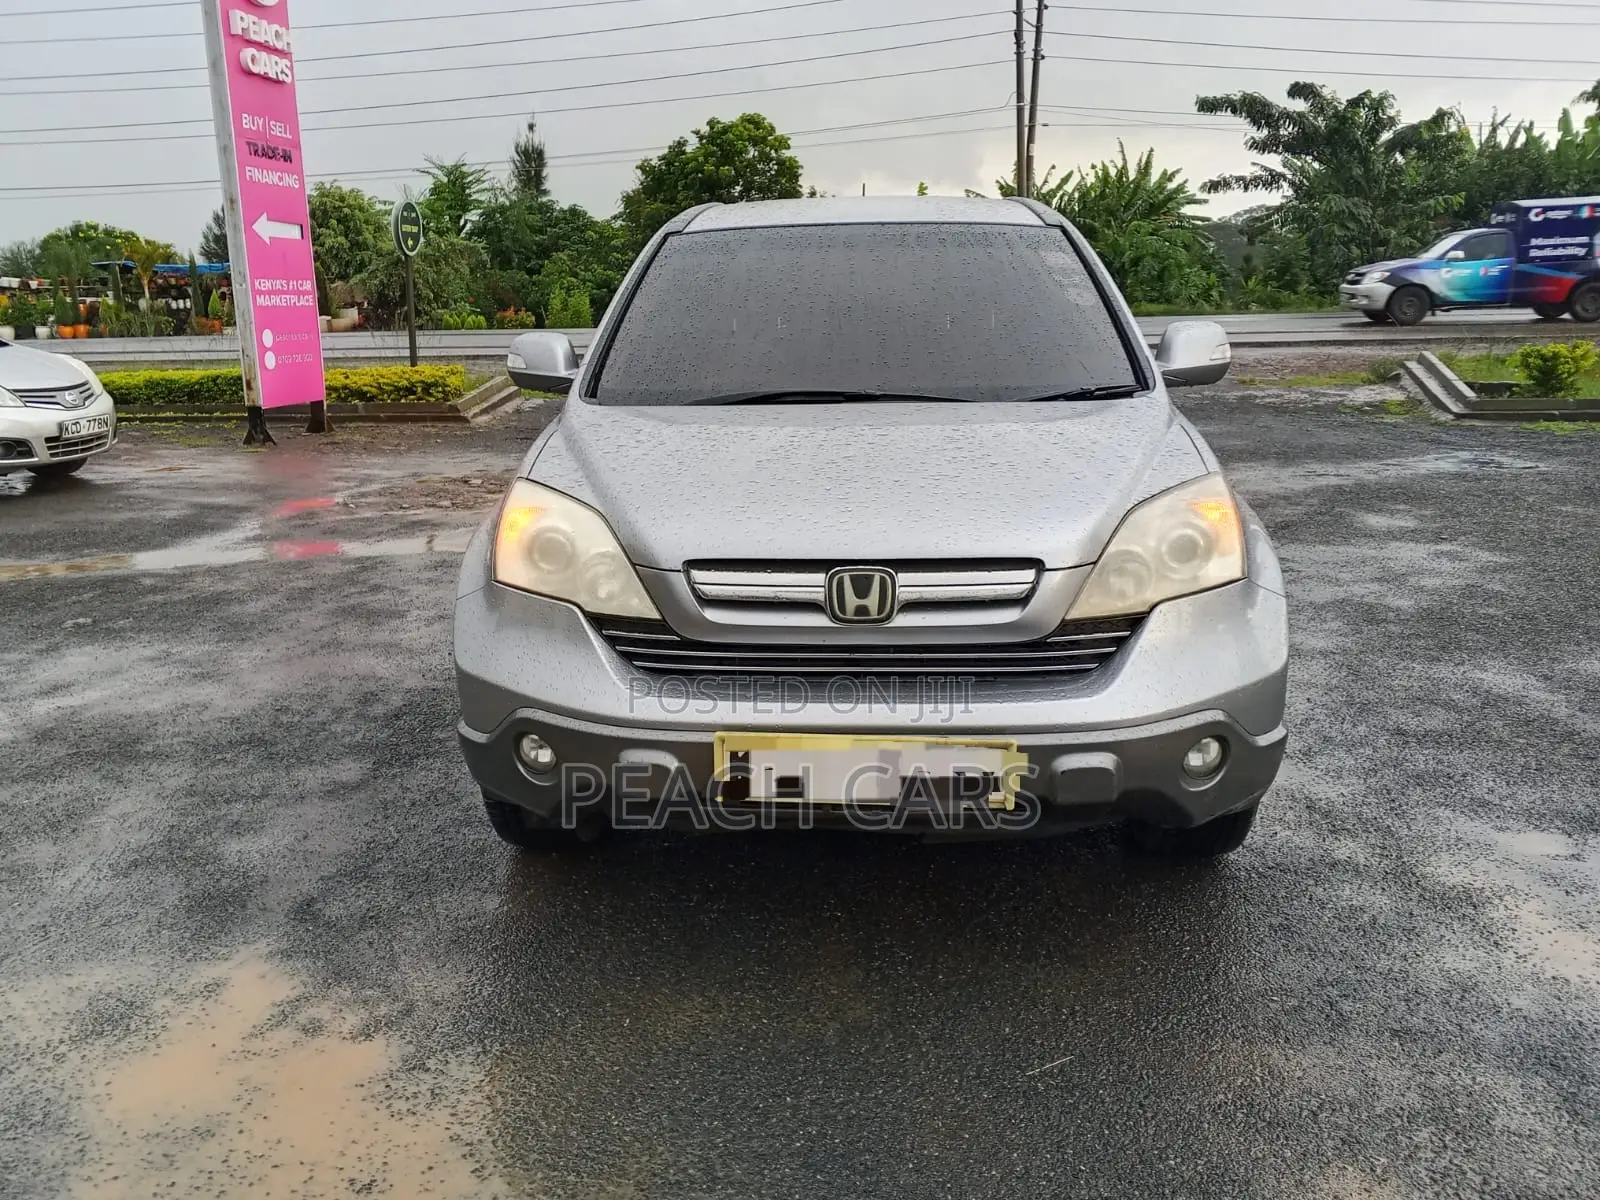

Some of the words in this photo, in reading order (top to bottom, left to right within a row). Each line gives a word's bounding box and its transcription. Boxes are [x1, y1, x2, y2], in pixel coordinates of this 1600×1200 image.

[228, 9, 292, 53] PEACH
[240, 47, 292, 84] CARS
[241, 113, 264, 132] BUY
[269, 120, 292, 139] SELL
[246, 141, 293, 164] TRADE-IN
[245, 166, 300, 188] FINANCING
[254, 278, 288, 291] KENYA'S
[298, 280, 312, 291] CAR
[256, 294, 314, 307] MARKETPLACE
[64, 421, 82, 436] KCD
[86, 416, 109, 431] 778N
